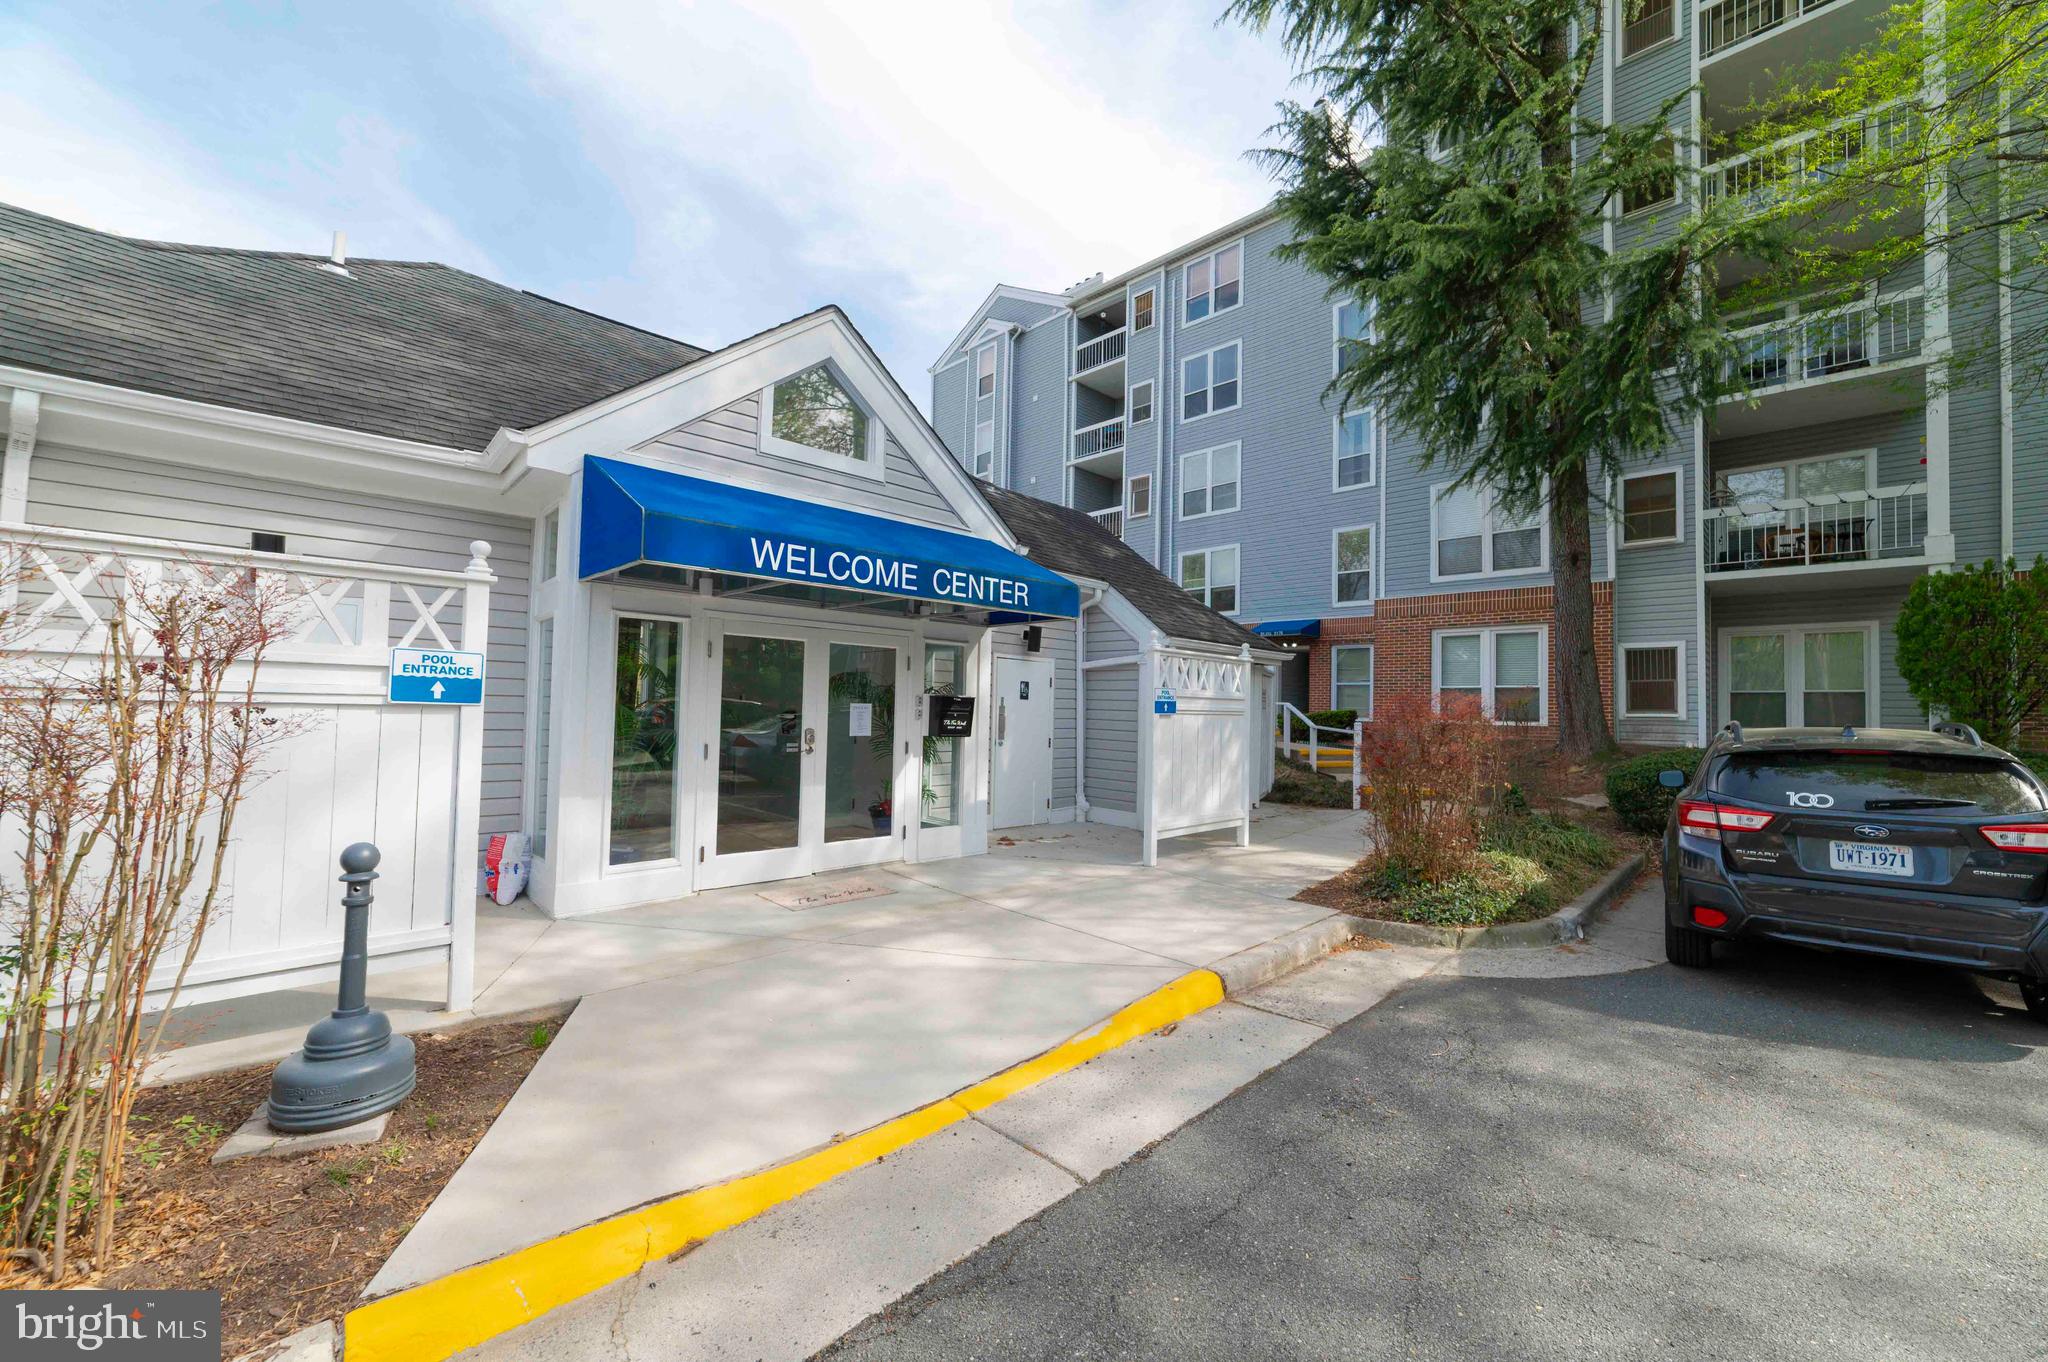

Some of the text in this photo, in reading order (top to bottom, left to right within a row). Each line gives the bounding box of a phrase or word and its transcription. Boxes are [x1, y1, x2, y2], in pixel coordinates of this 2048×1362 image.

[750, 537, 1029, 606] WELCOME CENTER
[422, 654, 456, 665] POOL
[402, 663, 474, 676] ENTRANCE
[1786, 791, 1835, 808] 100
[1851, 843, 1890, 852] VIRGINIA
[1836, 848, 1907, 867] UWT-1971
